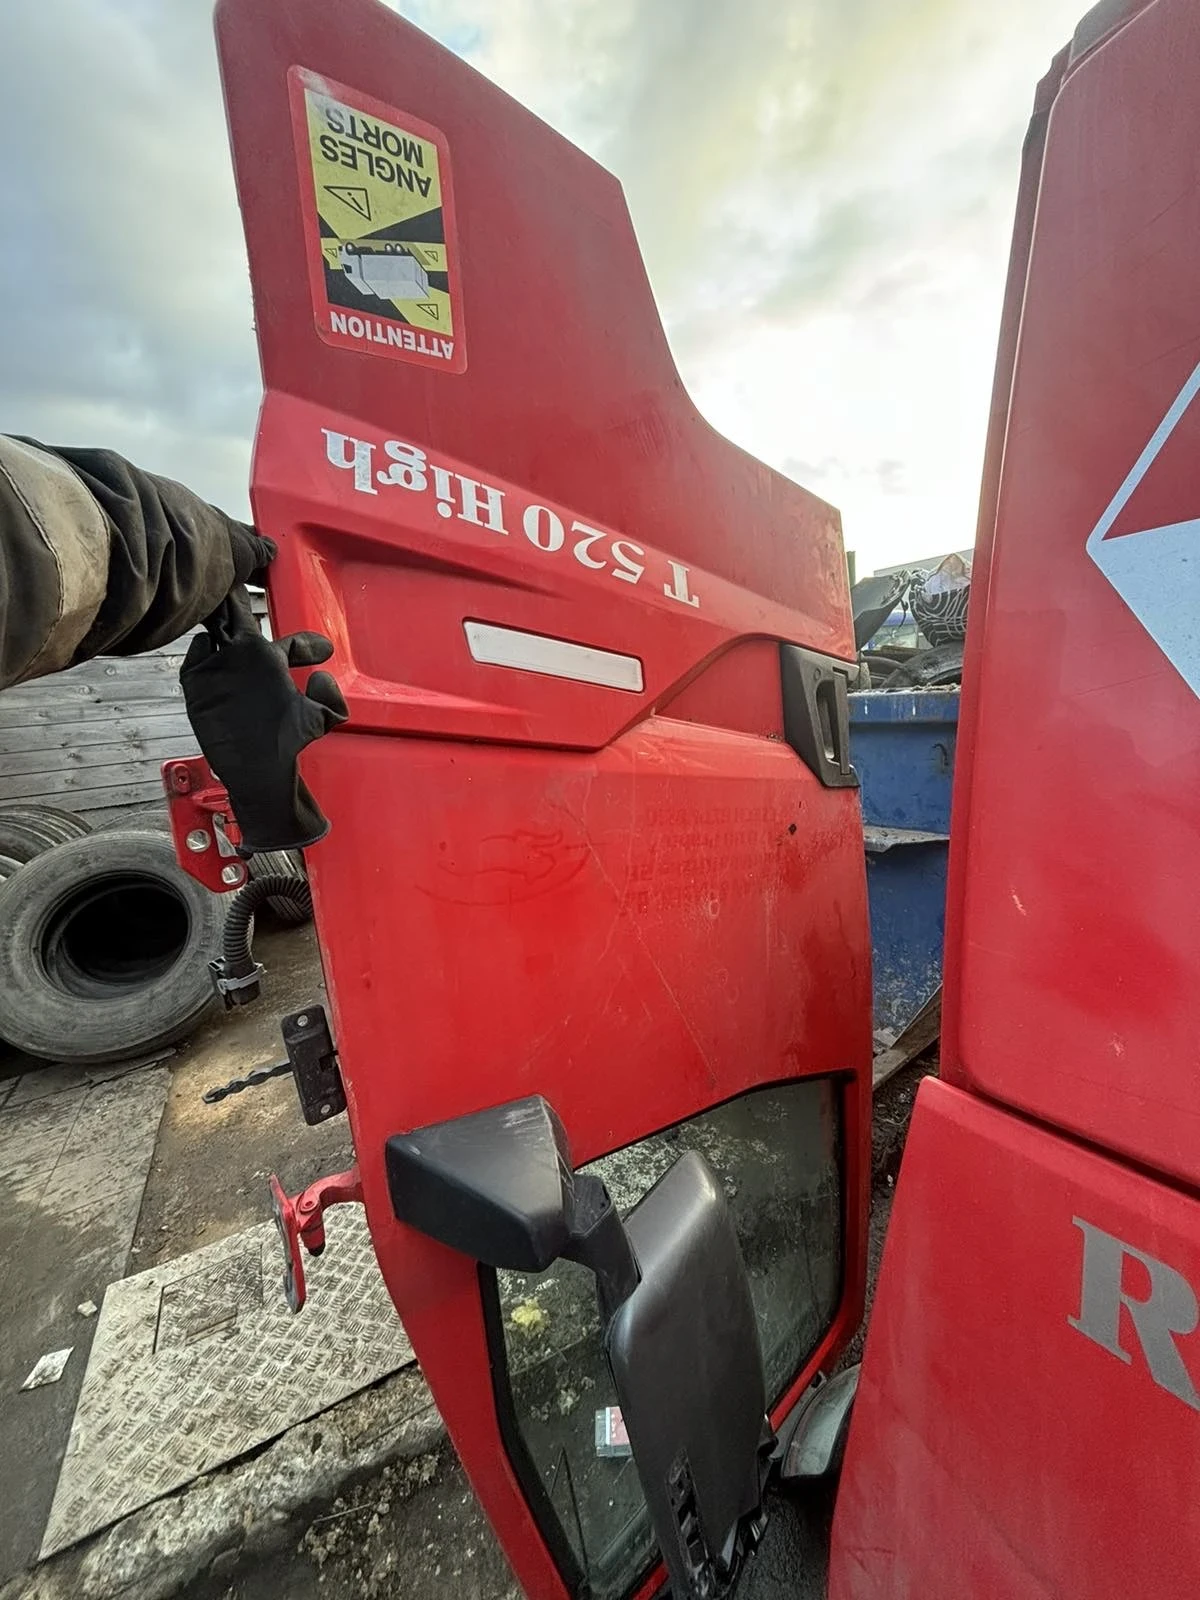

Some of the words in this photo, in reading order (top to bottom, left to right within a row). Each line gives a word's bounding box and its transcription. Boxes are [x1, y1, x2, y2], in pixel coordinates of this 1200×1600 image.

[320, 135, 431, 198] ANGLES
[326, 108, 424, 169] MORTS
[330, 311, 454, 360] ATTENTION
[321, 427, 509, 535] High
[522, 504, 646, 584] 520
[663, 559, 699, 608] T
[1067, 1215, 1200, 1412] R
